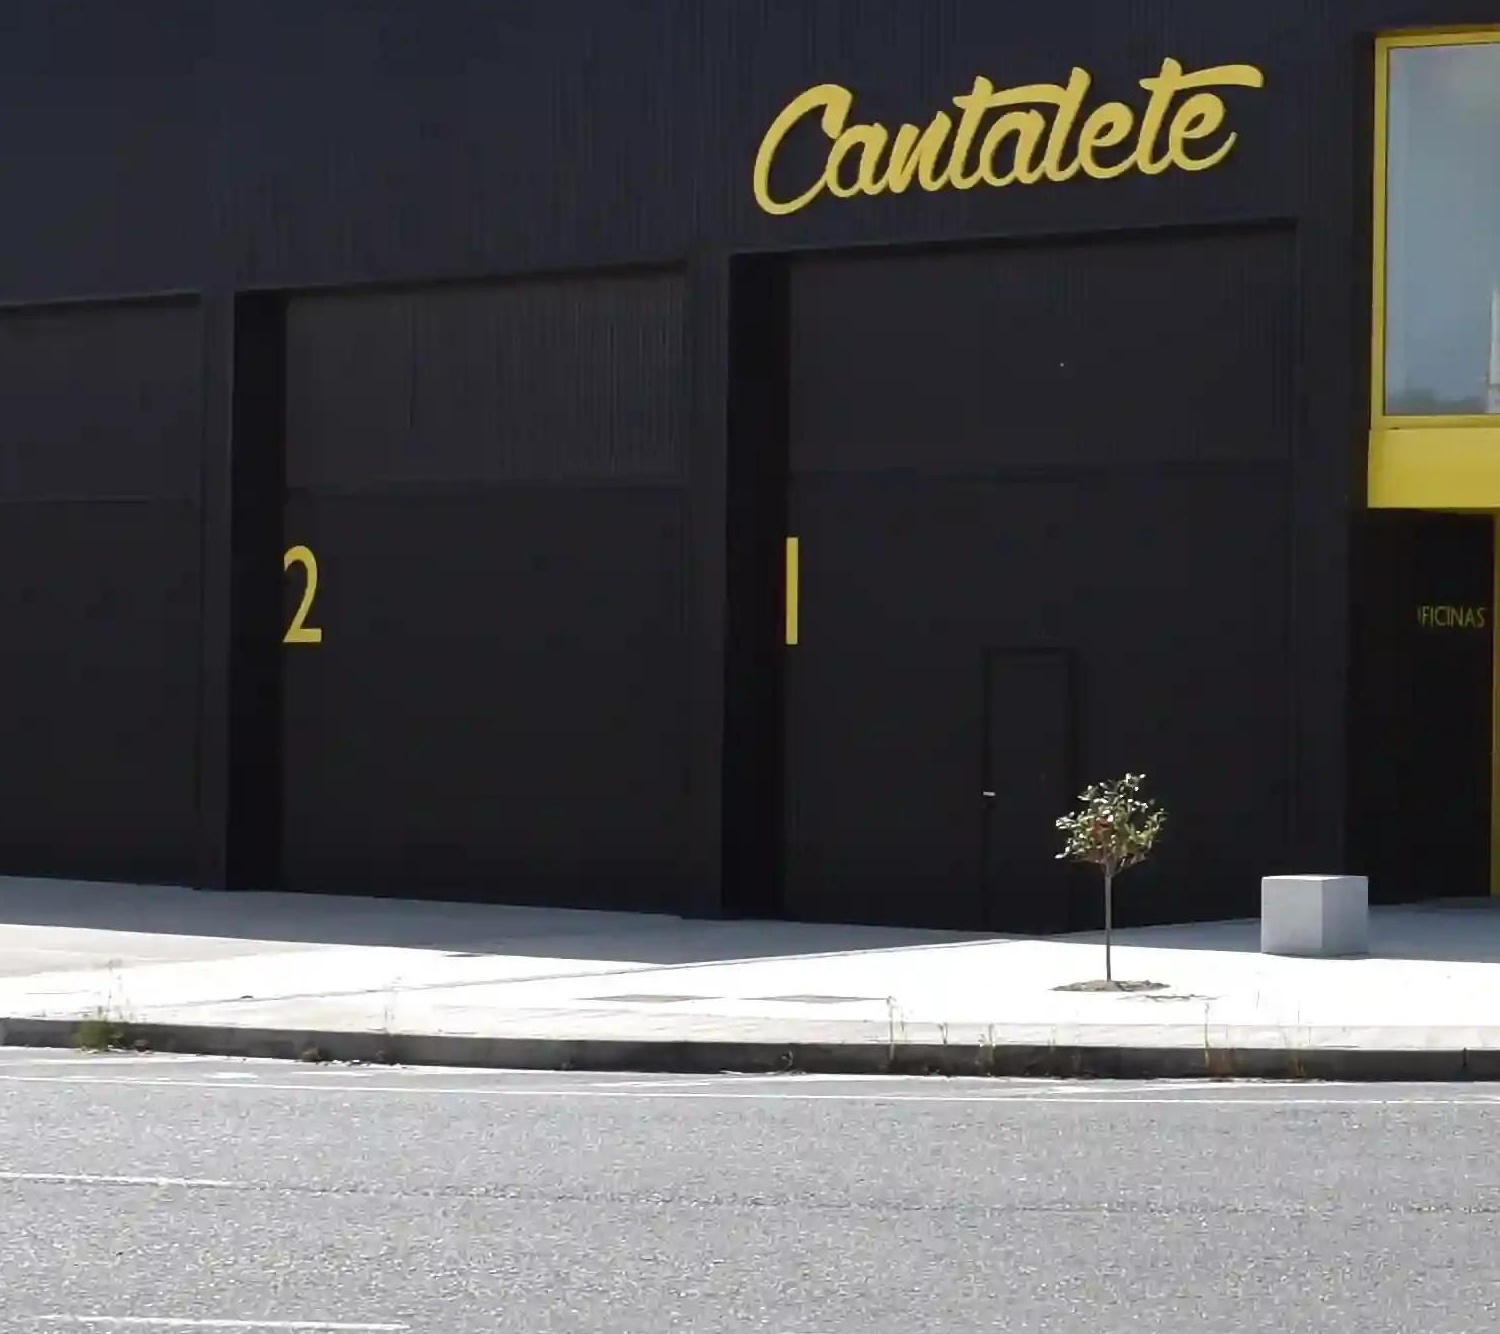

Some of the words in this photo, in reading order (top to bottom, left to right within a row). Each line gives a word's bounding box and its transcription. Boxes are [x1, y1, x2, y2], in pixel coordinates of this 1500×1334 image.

[753, 56, 1265, 216] Cantalete
[283, 546, 323, 644] 2
[785, 536, 801, 645] 1
